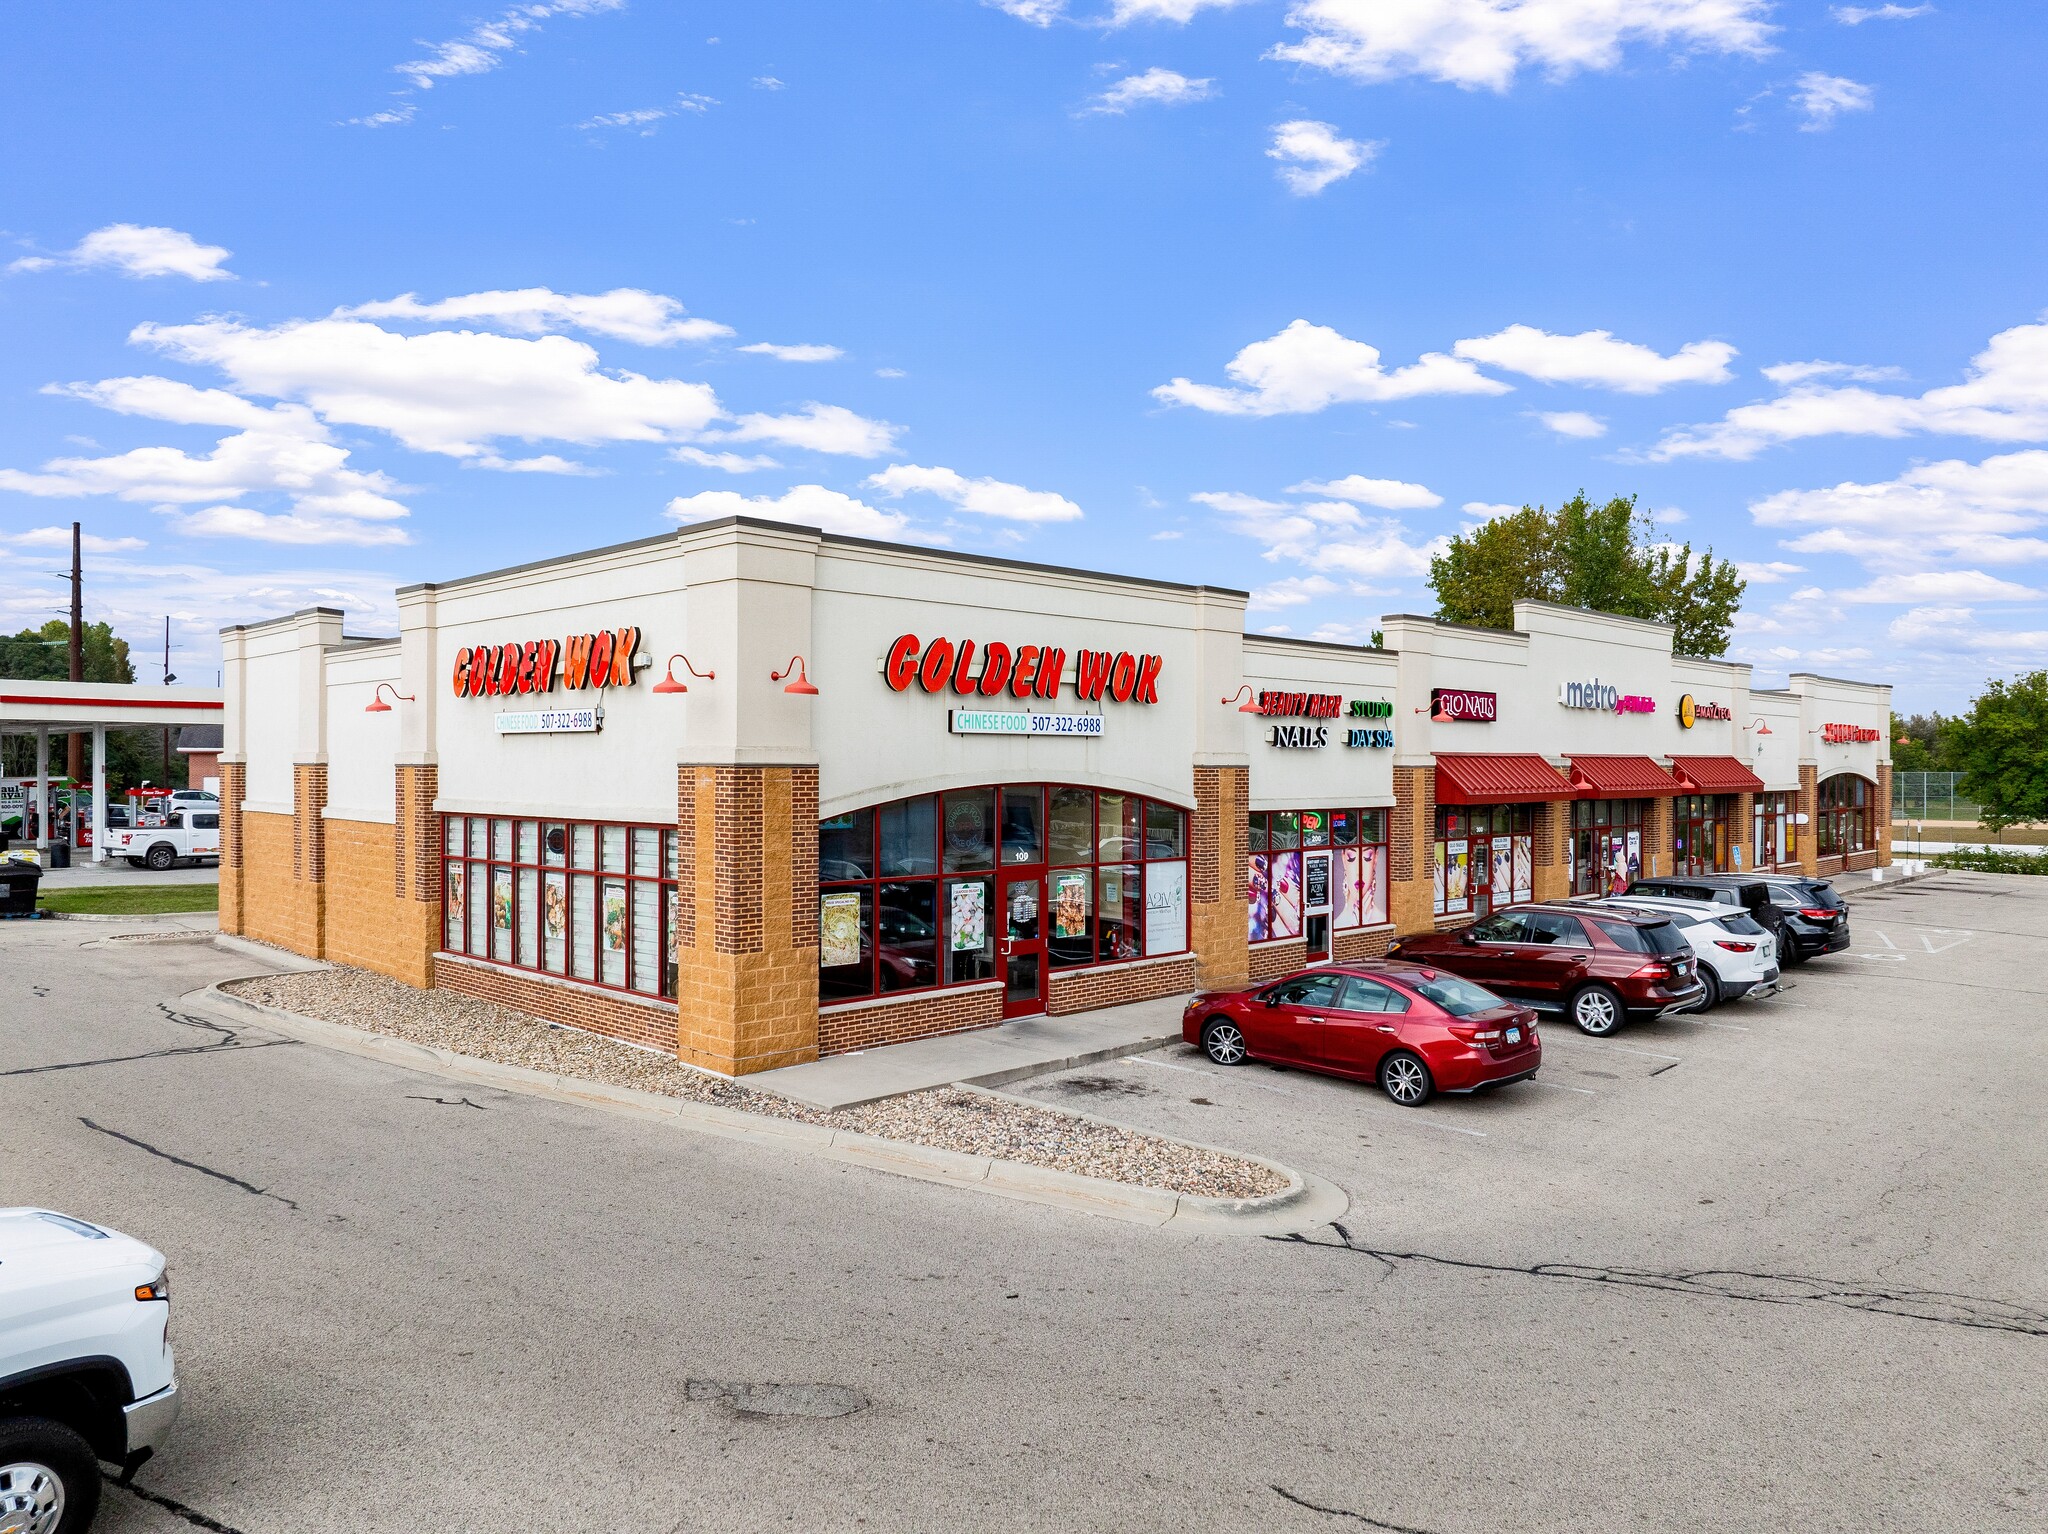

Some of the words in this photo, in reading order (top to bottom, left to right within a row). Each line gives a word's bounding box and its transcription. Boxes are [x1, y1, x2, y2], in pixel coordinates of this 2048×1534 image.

[453, 638, 559, 698] GOLDEN
[564, 626, 641, 690] WOK
[884, 634, 1066, 699] GOLDEN
[1076, 649, 1162, 704] WOK
[1260, 691, 1307, 716] BEAUTY
[1308, 694, 1342, 718] MARK
[1566, 678, 1617, 710] metro
[1352, 700, 1393, 718] STUDIO
[1440, 694, 1460, 716] GLO
[1462, 693, 1495, 718] NAILS
[496, 714, 520, 730] CHINESE
[521, 714, 539, 729] FOOD
[541, 711, 593, 729] 507-322-6988
[957, 713, 999, 730] CHINESE
[1000, 715, 1027, 731] FOOD
[1032, 716, 1101, 733] 507-322-6988
[1275, 725, 1329, 748] NAILS
[1350, 729, 1374, 748] DAY
[1375, 730, 1395, 748] SPA
[1296, 814, 1318, 830] PEN
[1015, 852, 1029, 861] 100
